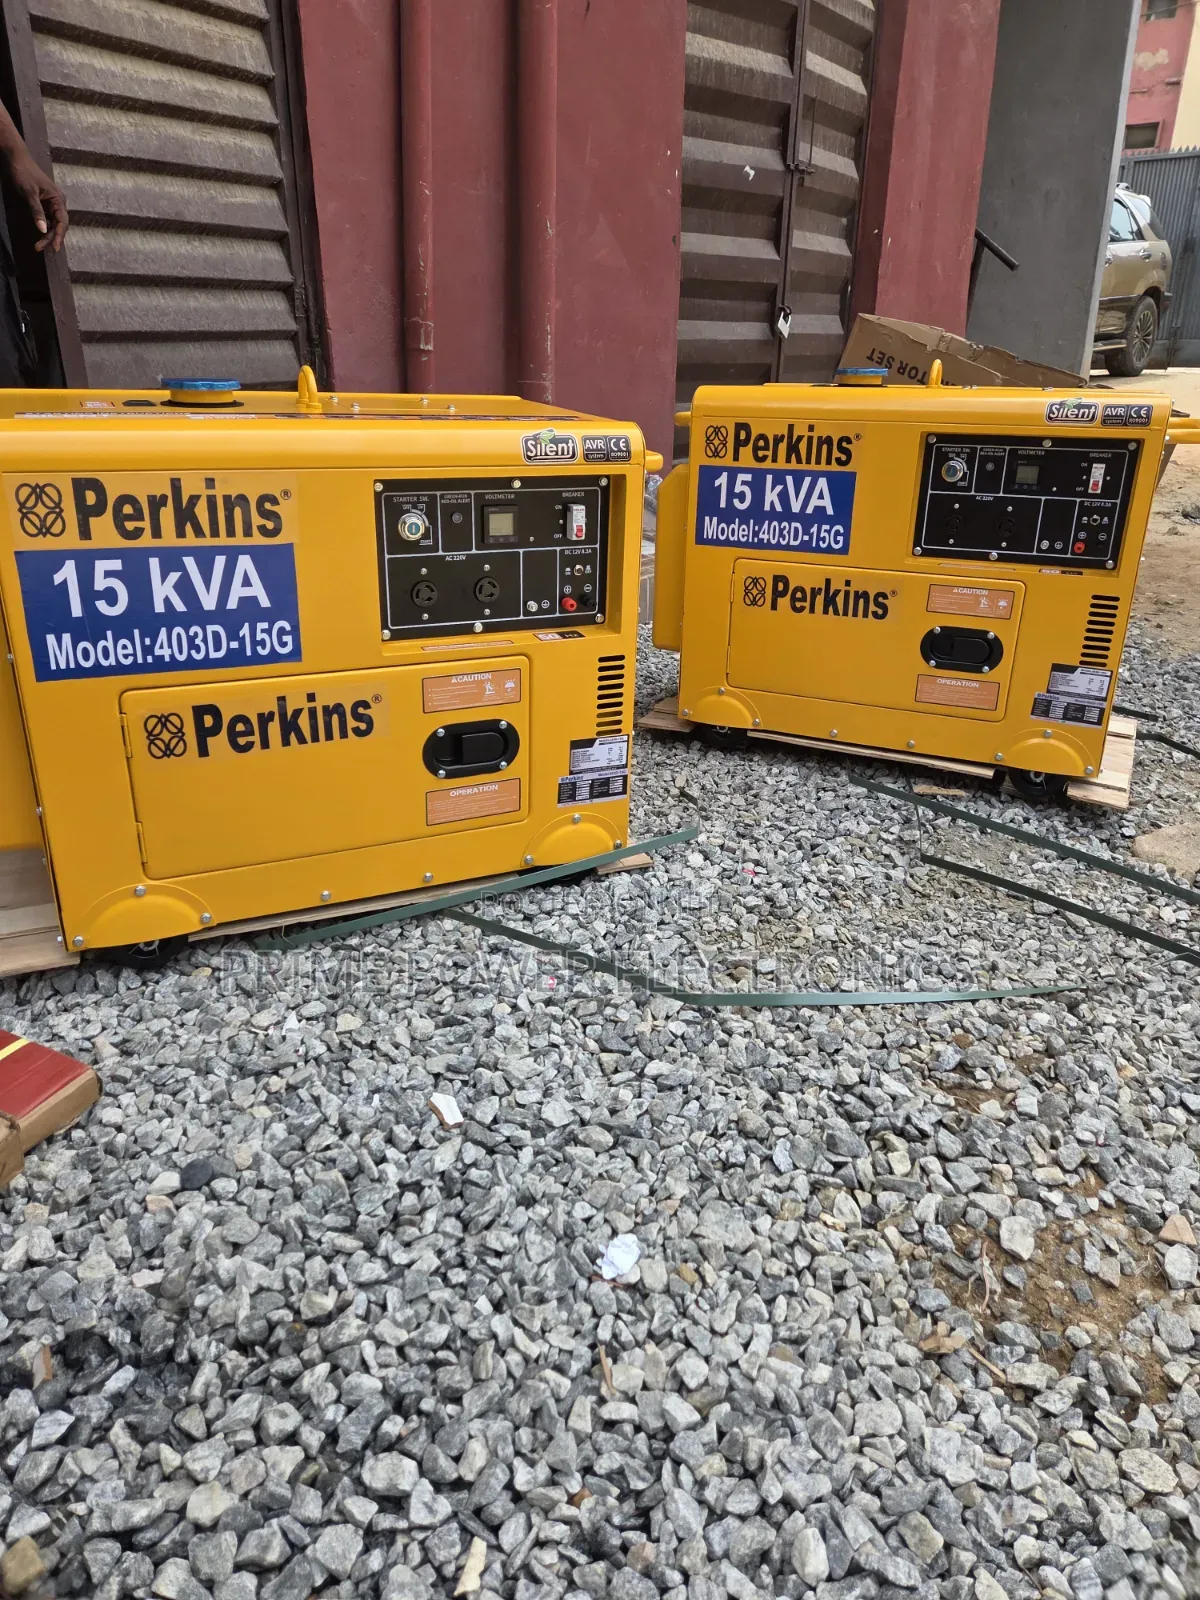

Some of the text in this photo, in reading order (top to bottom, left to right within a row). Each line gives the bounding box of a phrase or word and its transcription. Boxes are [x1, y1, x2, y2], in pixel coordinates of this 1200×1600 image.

[866, 347, 896, 370] SET
[1049, 404, 1096, 419] Silent
[1104, 407, 1125, 416] AVR
[526, 439, 575, 457] Silent
[585, 439, 606, 450] AVR
[714, 471, 835, 516] 15 kVA
[703, 515, 845, 550] Model:403D-15G
[53, 554, 272, 618] 15 kVA
[958, 587, 989, 596] CAUTION
[46, 619, 294, 671] Model:403D-15G
[457, 672, 492, 684] CAUTION
[937, 678, 980, 688] OPERATION
[449, 784, 499, 797] OPERATION
